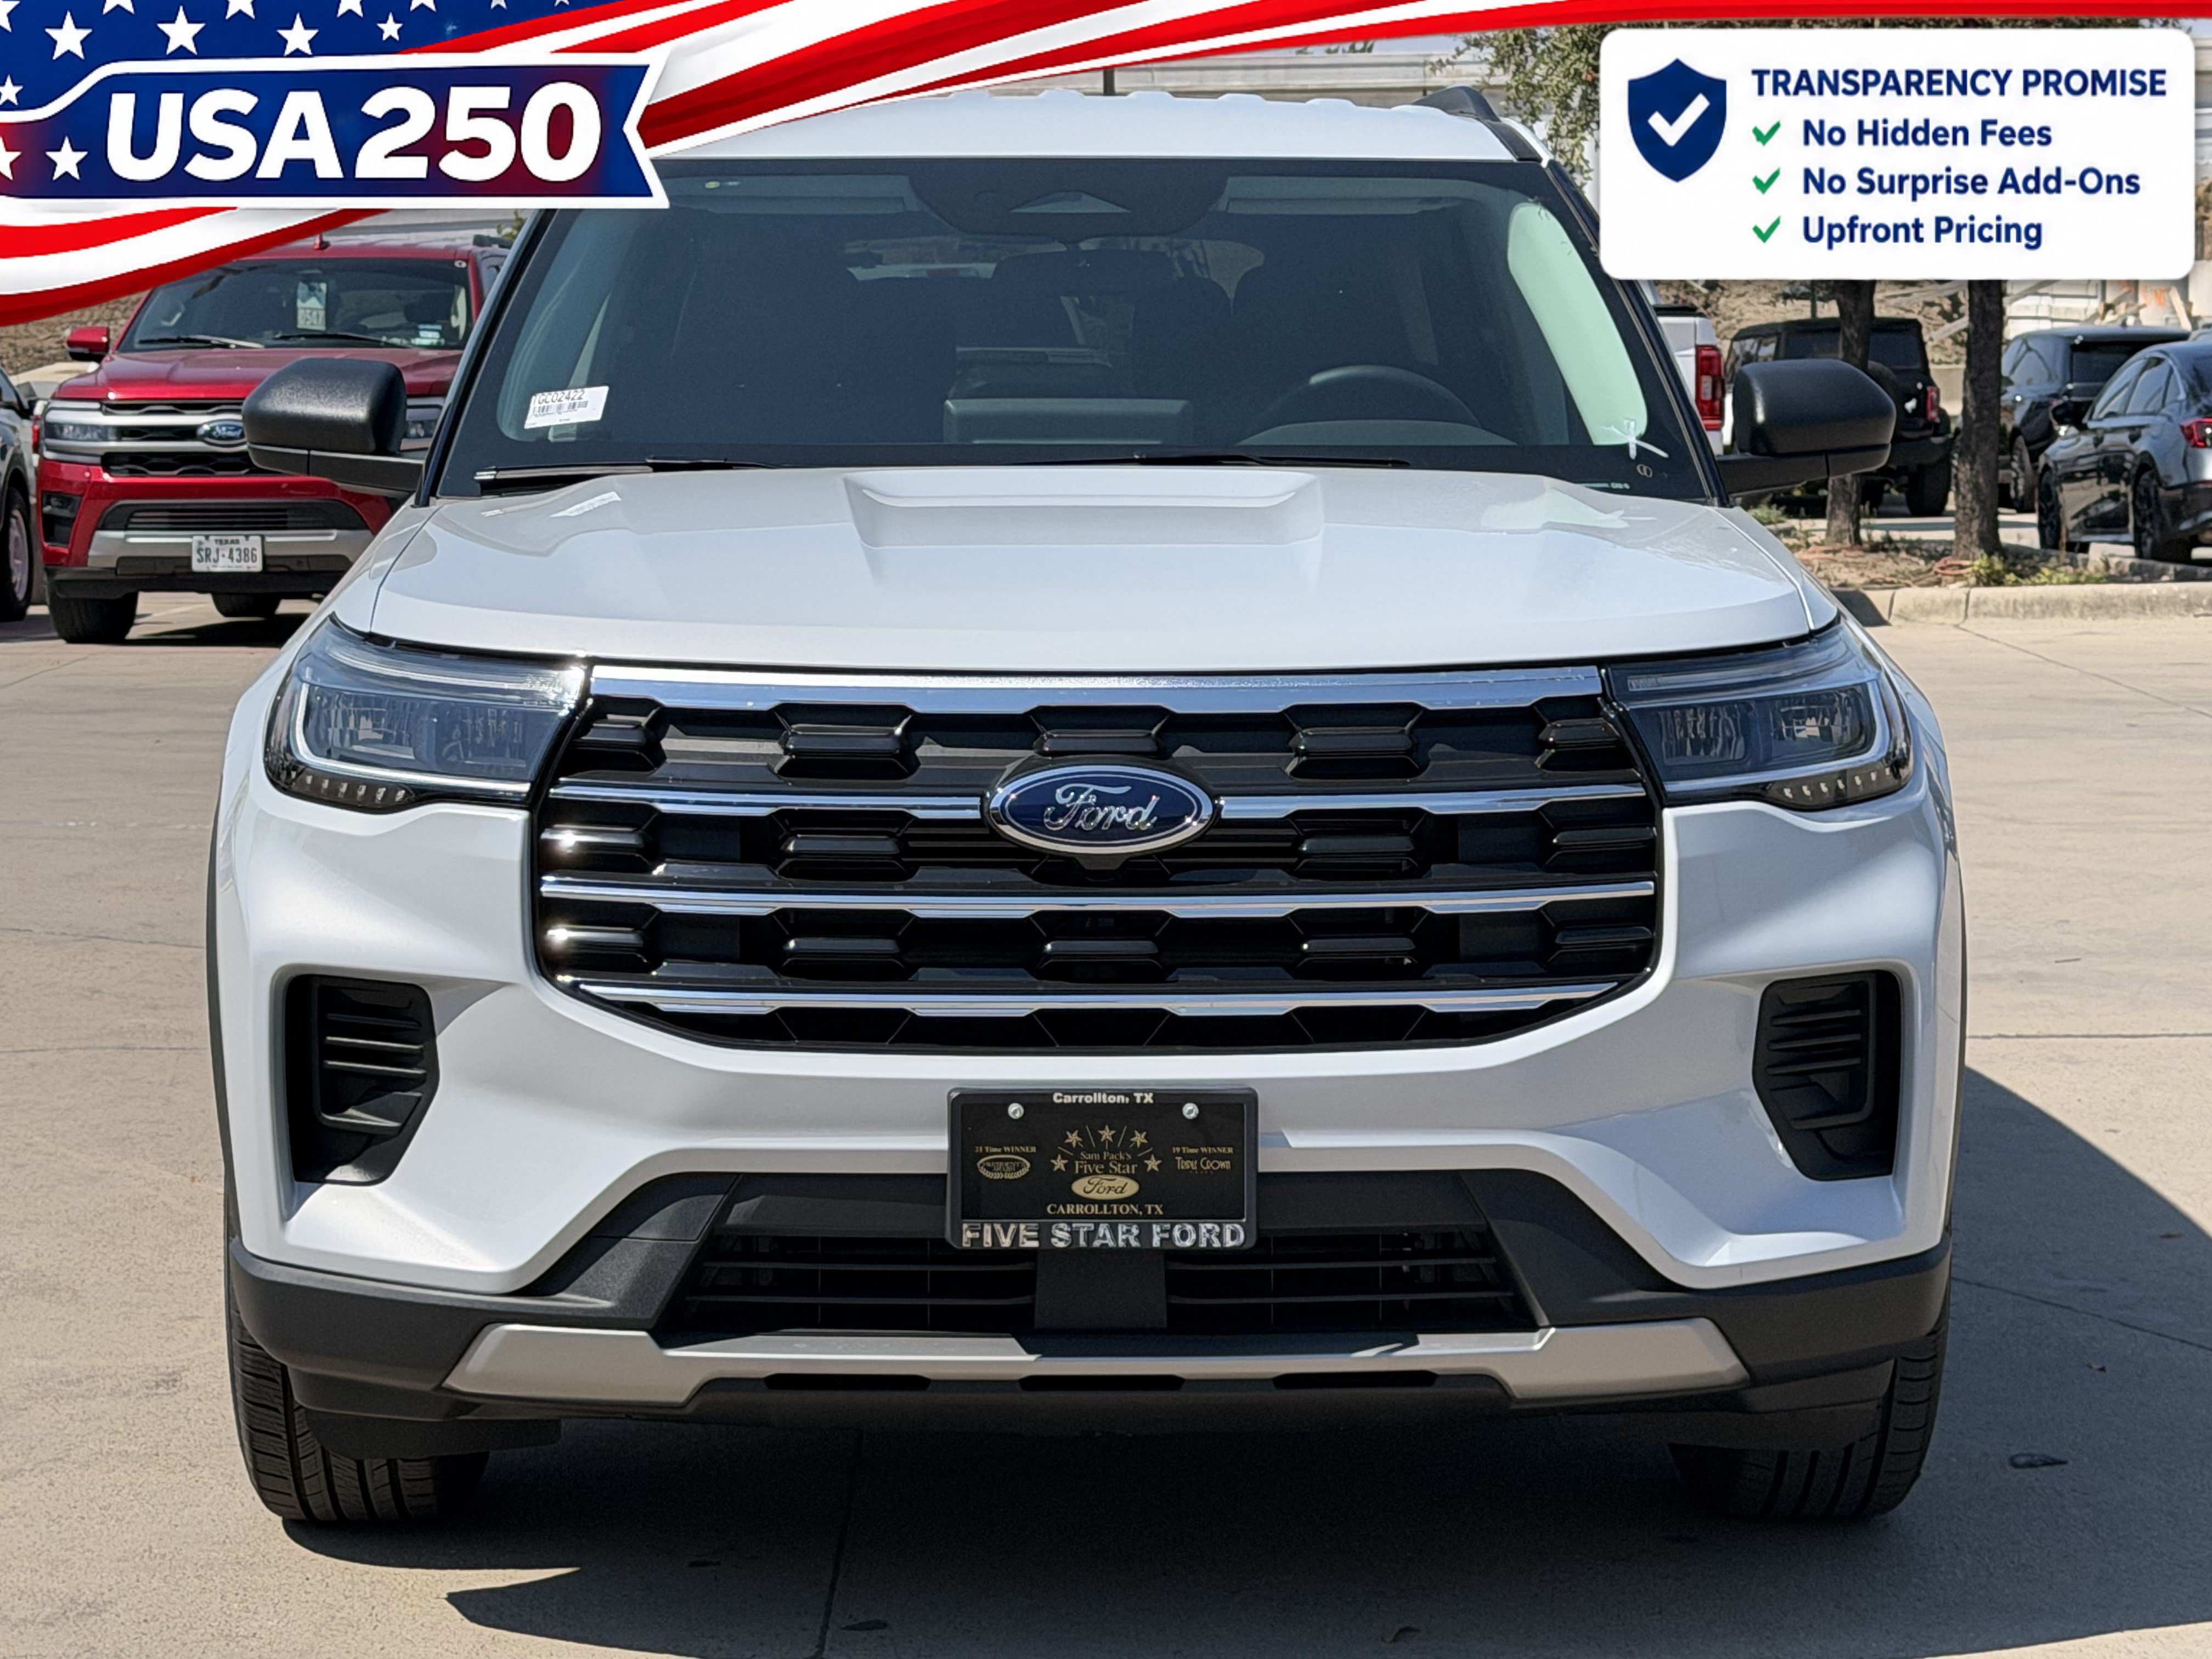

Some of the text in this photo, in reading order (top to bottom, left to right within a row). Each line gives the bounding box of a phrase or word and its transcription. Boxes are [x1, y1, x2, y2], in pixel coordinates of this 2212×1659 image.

[1043, 783, 1160, 831] Ford
[1133, 1092, 1154, 1104] TX
[1080, 1152, 1100, 1160] Sam
[1075, 1160, 1138, 1174] Five Star
[1083, 1176, 1128, 1195] Ford
[1046, 1204, 1164, 1216] CARROLLTON, TX
[962, 1222, 1245, 1248] FIVE STAR FORD
